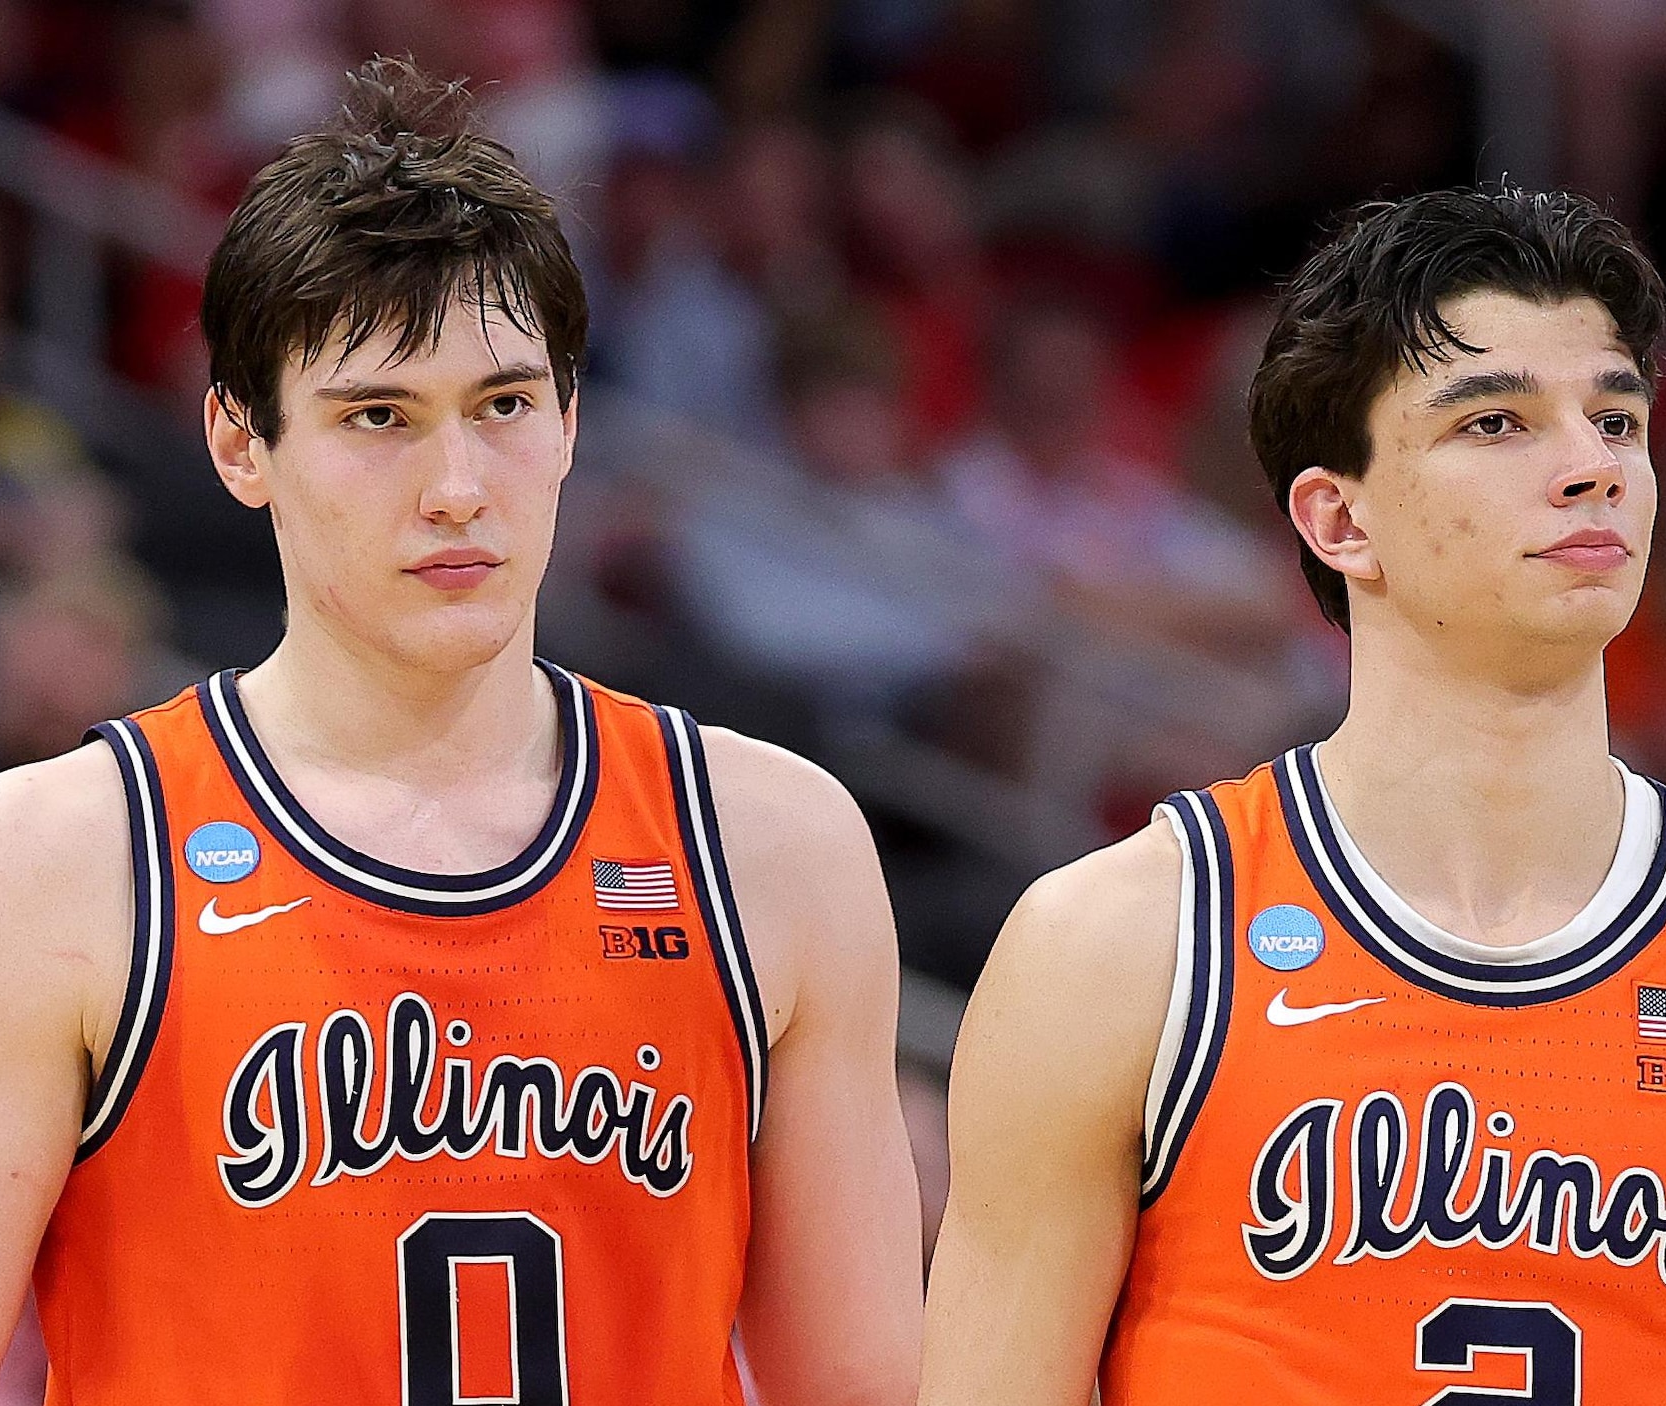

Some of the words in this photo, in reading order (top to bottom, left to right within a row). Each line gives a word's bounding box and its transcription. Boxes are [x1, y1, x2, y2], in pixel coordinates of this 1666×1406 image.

[195, 849, 254, 867] NCAA
[1258, 934, 1317, 953] NCAA
[216, 992, 693, 1208] Illinois
